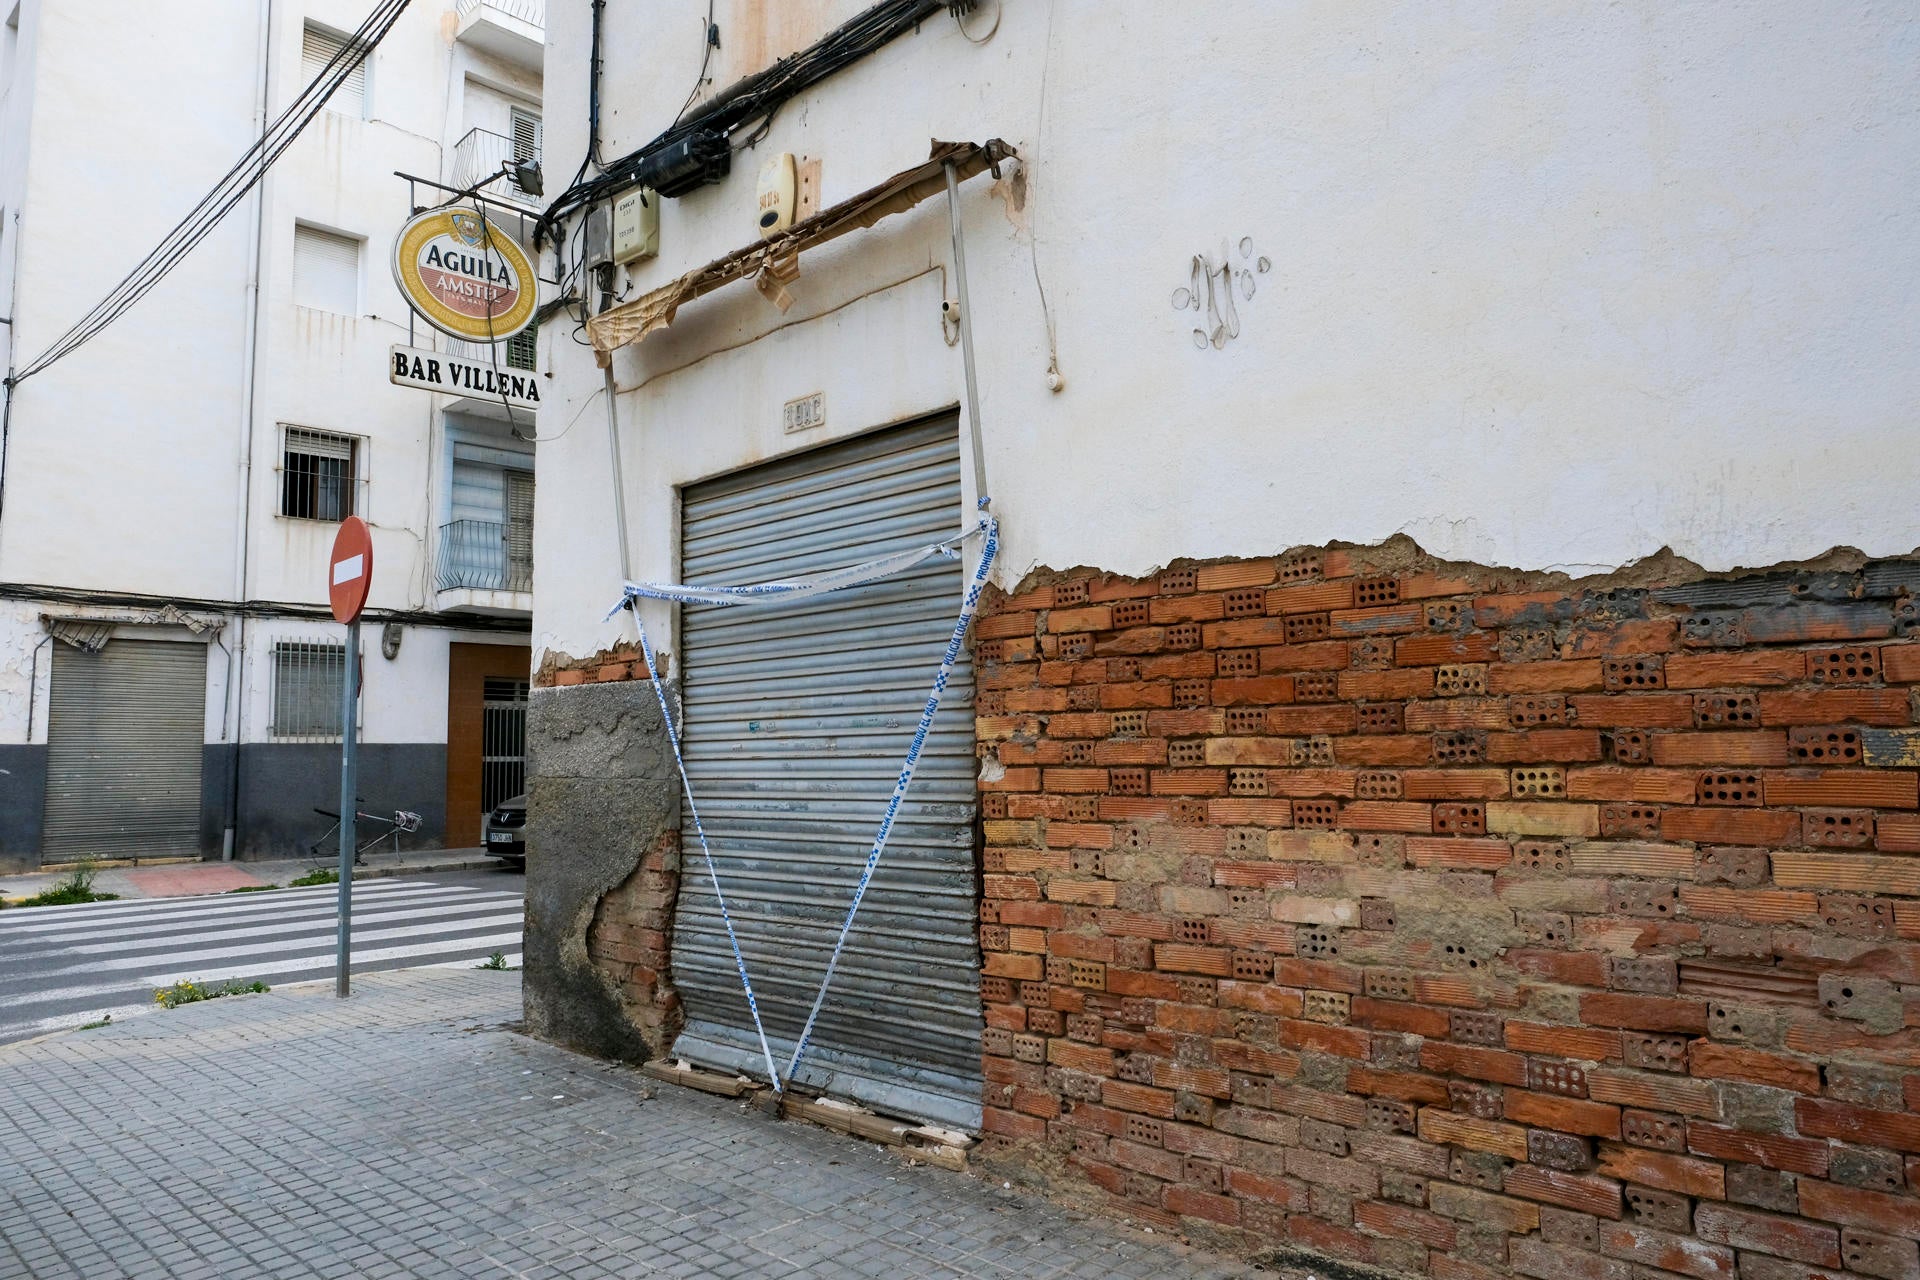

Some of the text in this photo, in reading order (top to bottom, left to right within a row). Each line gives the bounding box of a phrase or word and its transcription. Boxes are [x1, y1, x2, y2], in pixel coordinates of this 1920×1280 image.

[426, 244, 512, 286] AGUILA
[394, 352, 442, 384] BAR
[449, 362, 540, 402] VILLENA
[976, 540, 996, 581] PROHIBIDO
[944, 613, 972, 667] POLICIA LOCAL
